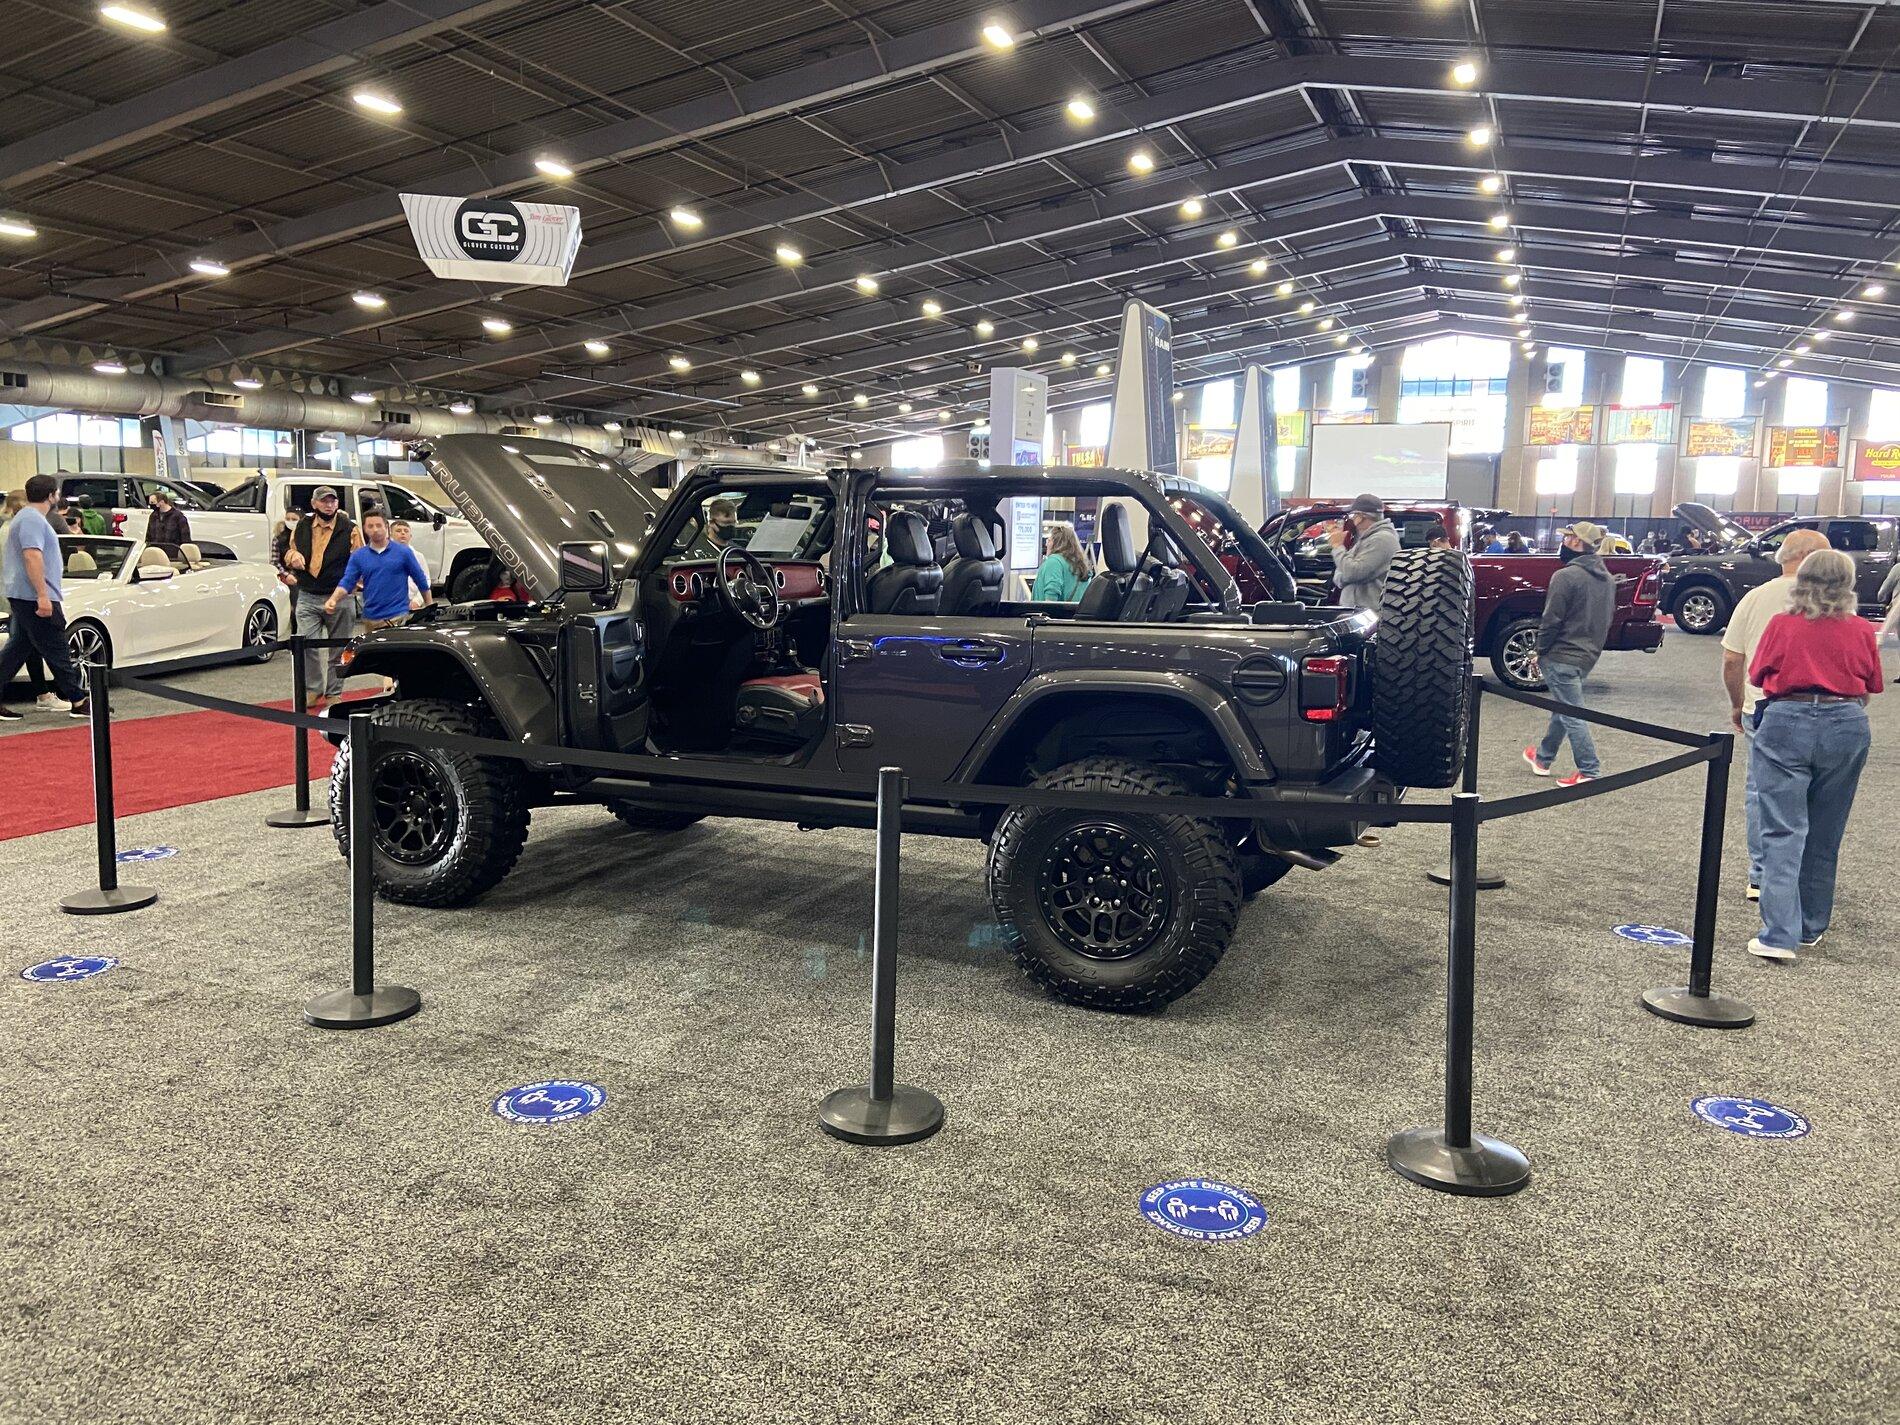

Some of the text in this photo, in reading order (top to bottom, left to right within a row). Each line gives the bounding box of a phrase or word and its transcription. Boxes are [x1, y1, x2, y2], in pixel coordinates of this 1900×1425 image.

[463, 241, 519, 251] GLOVER CUSTOMS
[1154, 336, 1170, 351] RAM
[1865, 447, 1890, 459] Hard
[432, 462, 538, 590] RUBICON
[553, 1080, 584, 1088] SAFE
[1145, 1181, 1257, 1208] KEEP SAFE DISTANCE
[1147, 1211, 1262, 1240] KEEP SAFE DISTANCE
